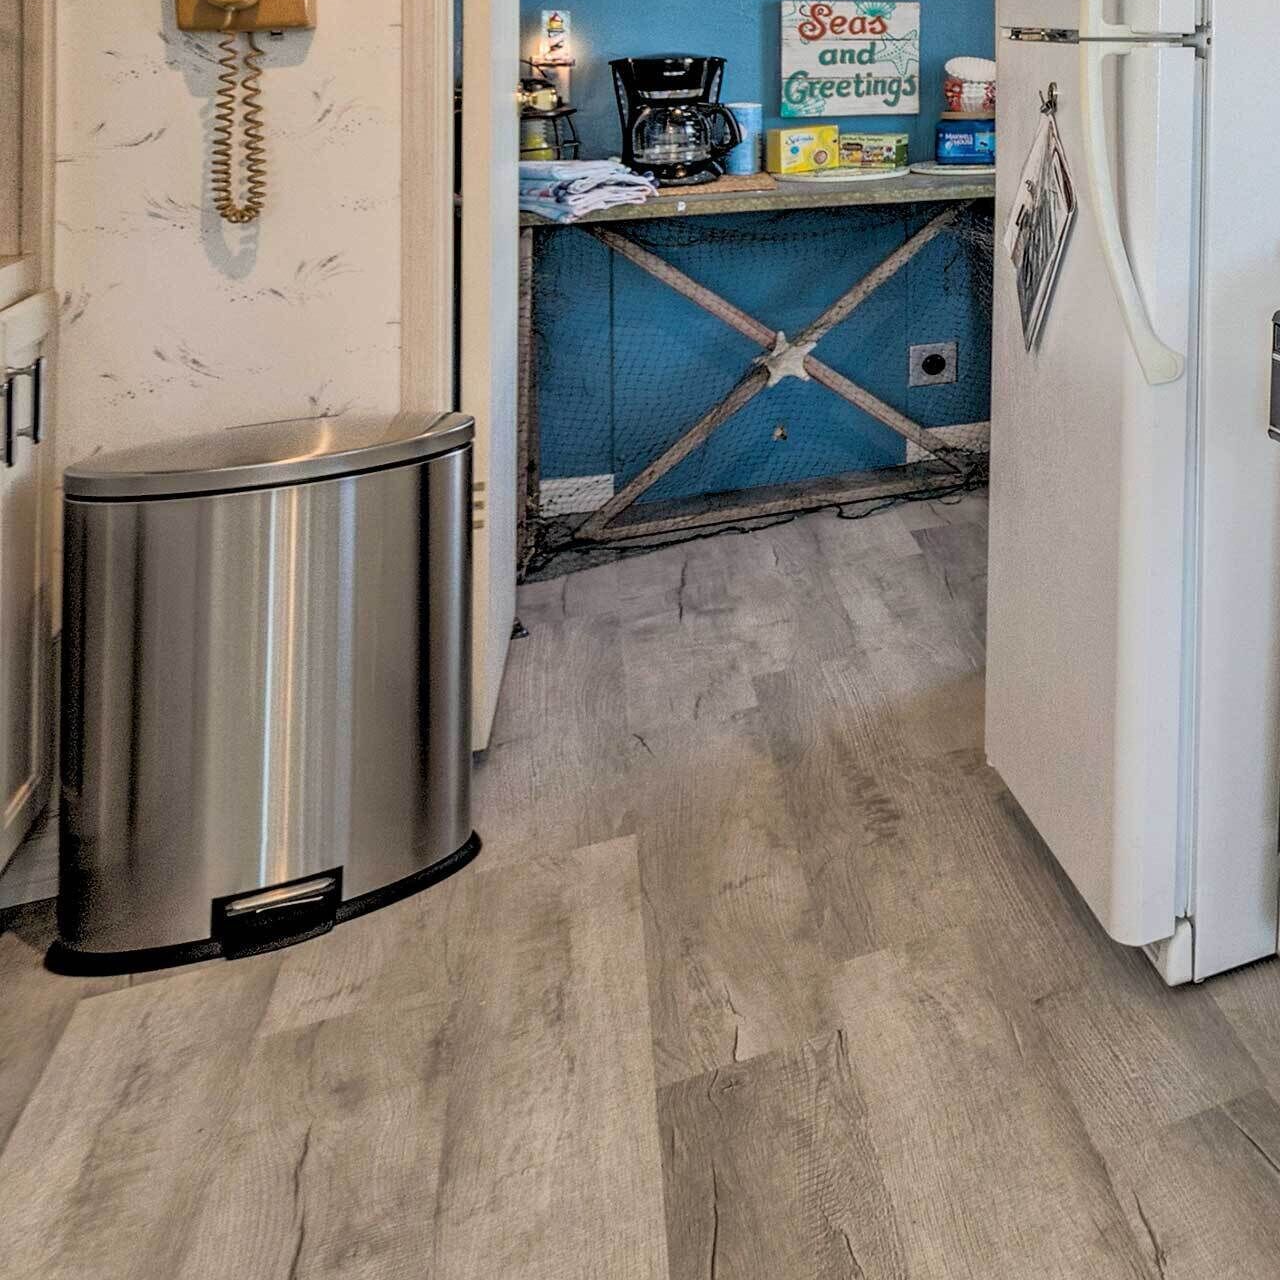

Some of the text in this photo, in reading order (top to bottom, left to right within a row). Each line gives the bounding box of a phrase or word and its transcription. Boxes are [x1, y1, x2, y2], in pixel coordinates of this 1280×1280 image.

[798, 3, 888, 41] Seas
[818, 41, 877, 66] and
[784, 70, 917, 107] Greetings
